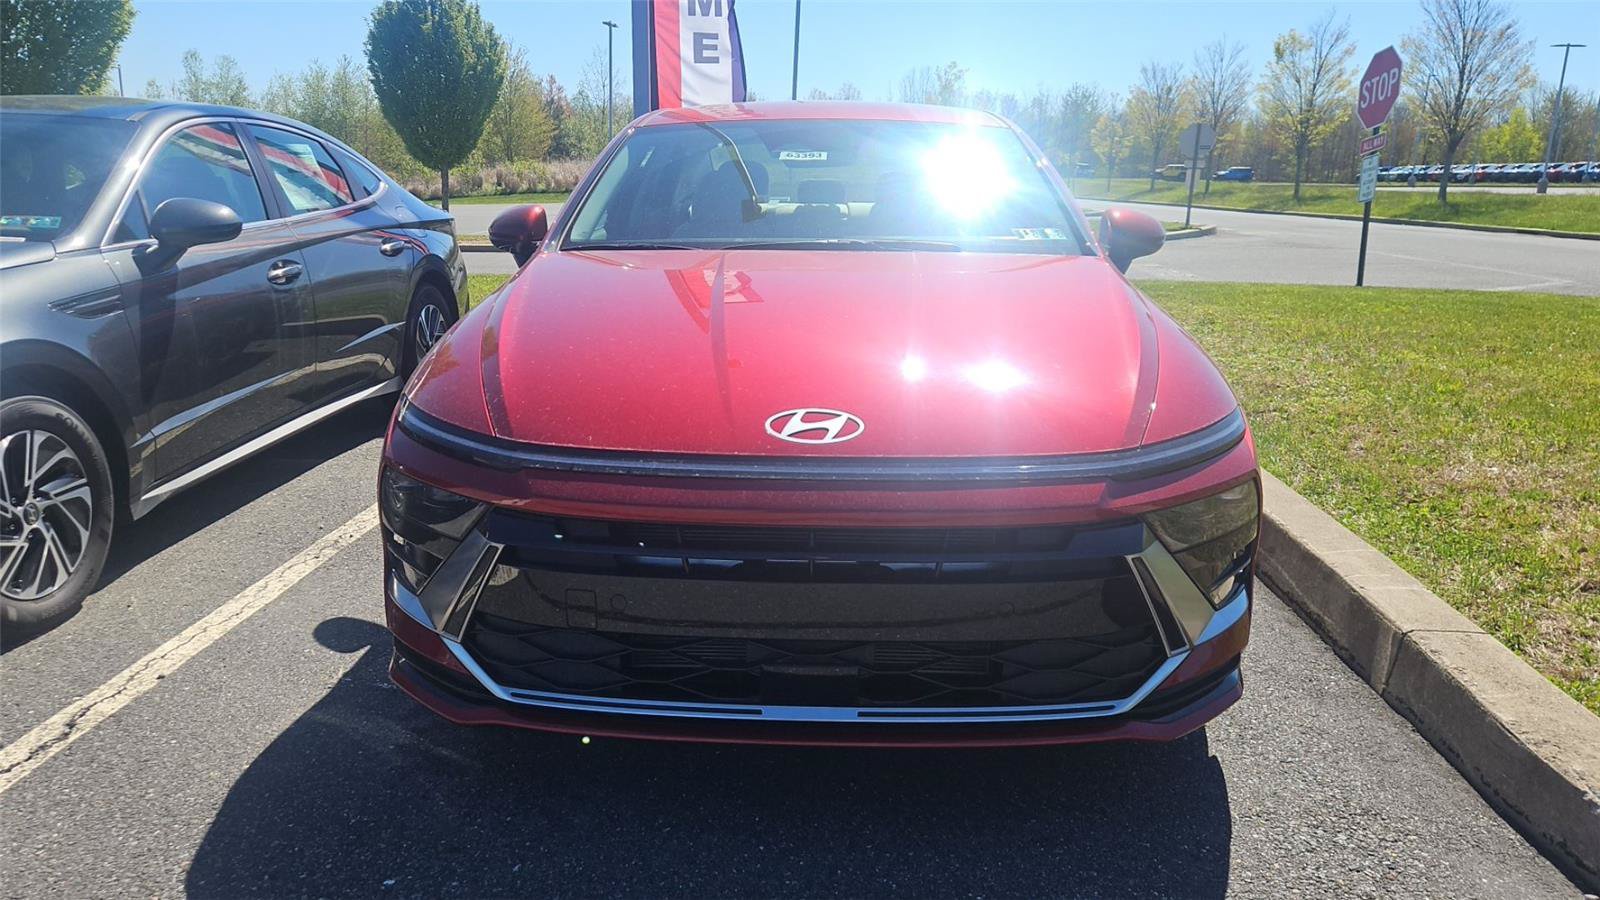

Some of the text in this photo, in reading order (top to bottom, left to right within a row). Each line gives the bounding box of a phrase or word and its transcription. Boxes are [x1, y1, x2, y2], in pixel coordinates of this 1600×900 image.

[1360, 67, 1399, 108] STOP
[1363, 135, 1384, 151] ALL WAY
